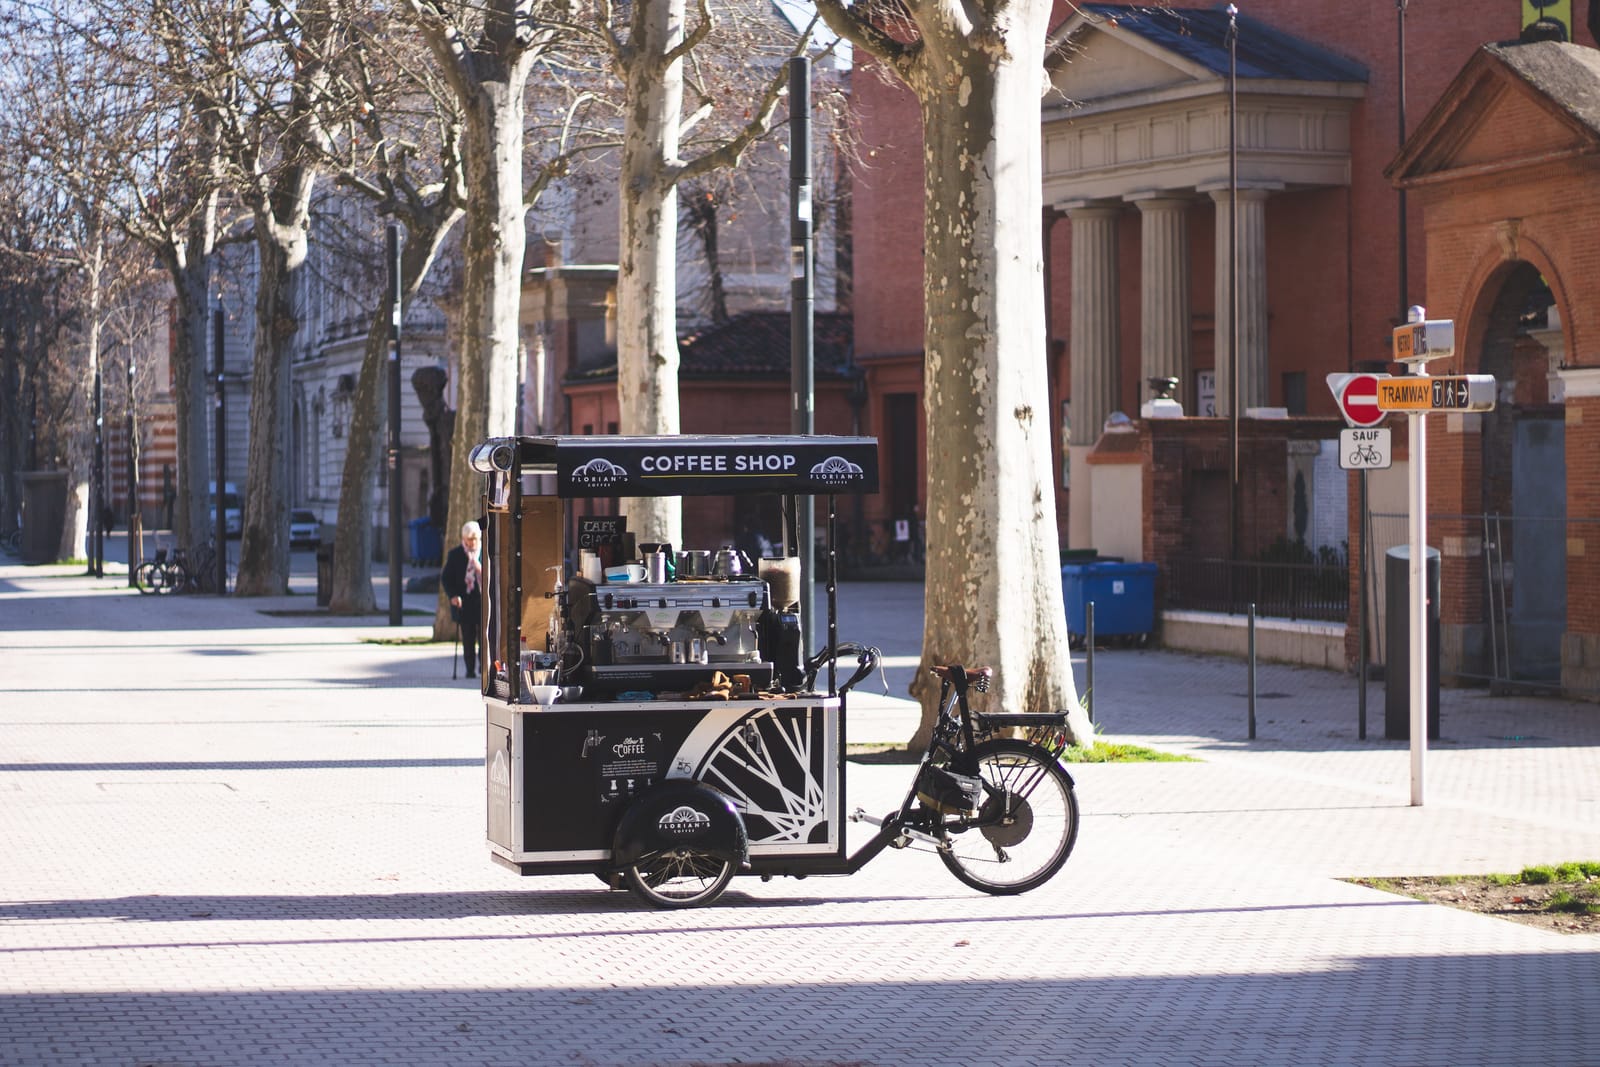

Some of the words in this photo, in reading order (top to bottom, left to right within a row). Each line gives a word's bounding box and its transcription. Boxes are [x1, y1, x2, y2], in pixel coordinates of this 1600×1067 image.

[1382, 385, 1430, 403] TRAMWAY
[1352, 431, 1380, 441] SAUF
[641, 455, 727, 471] COFFEE
[735, 454, 796, 471] SHOP
